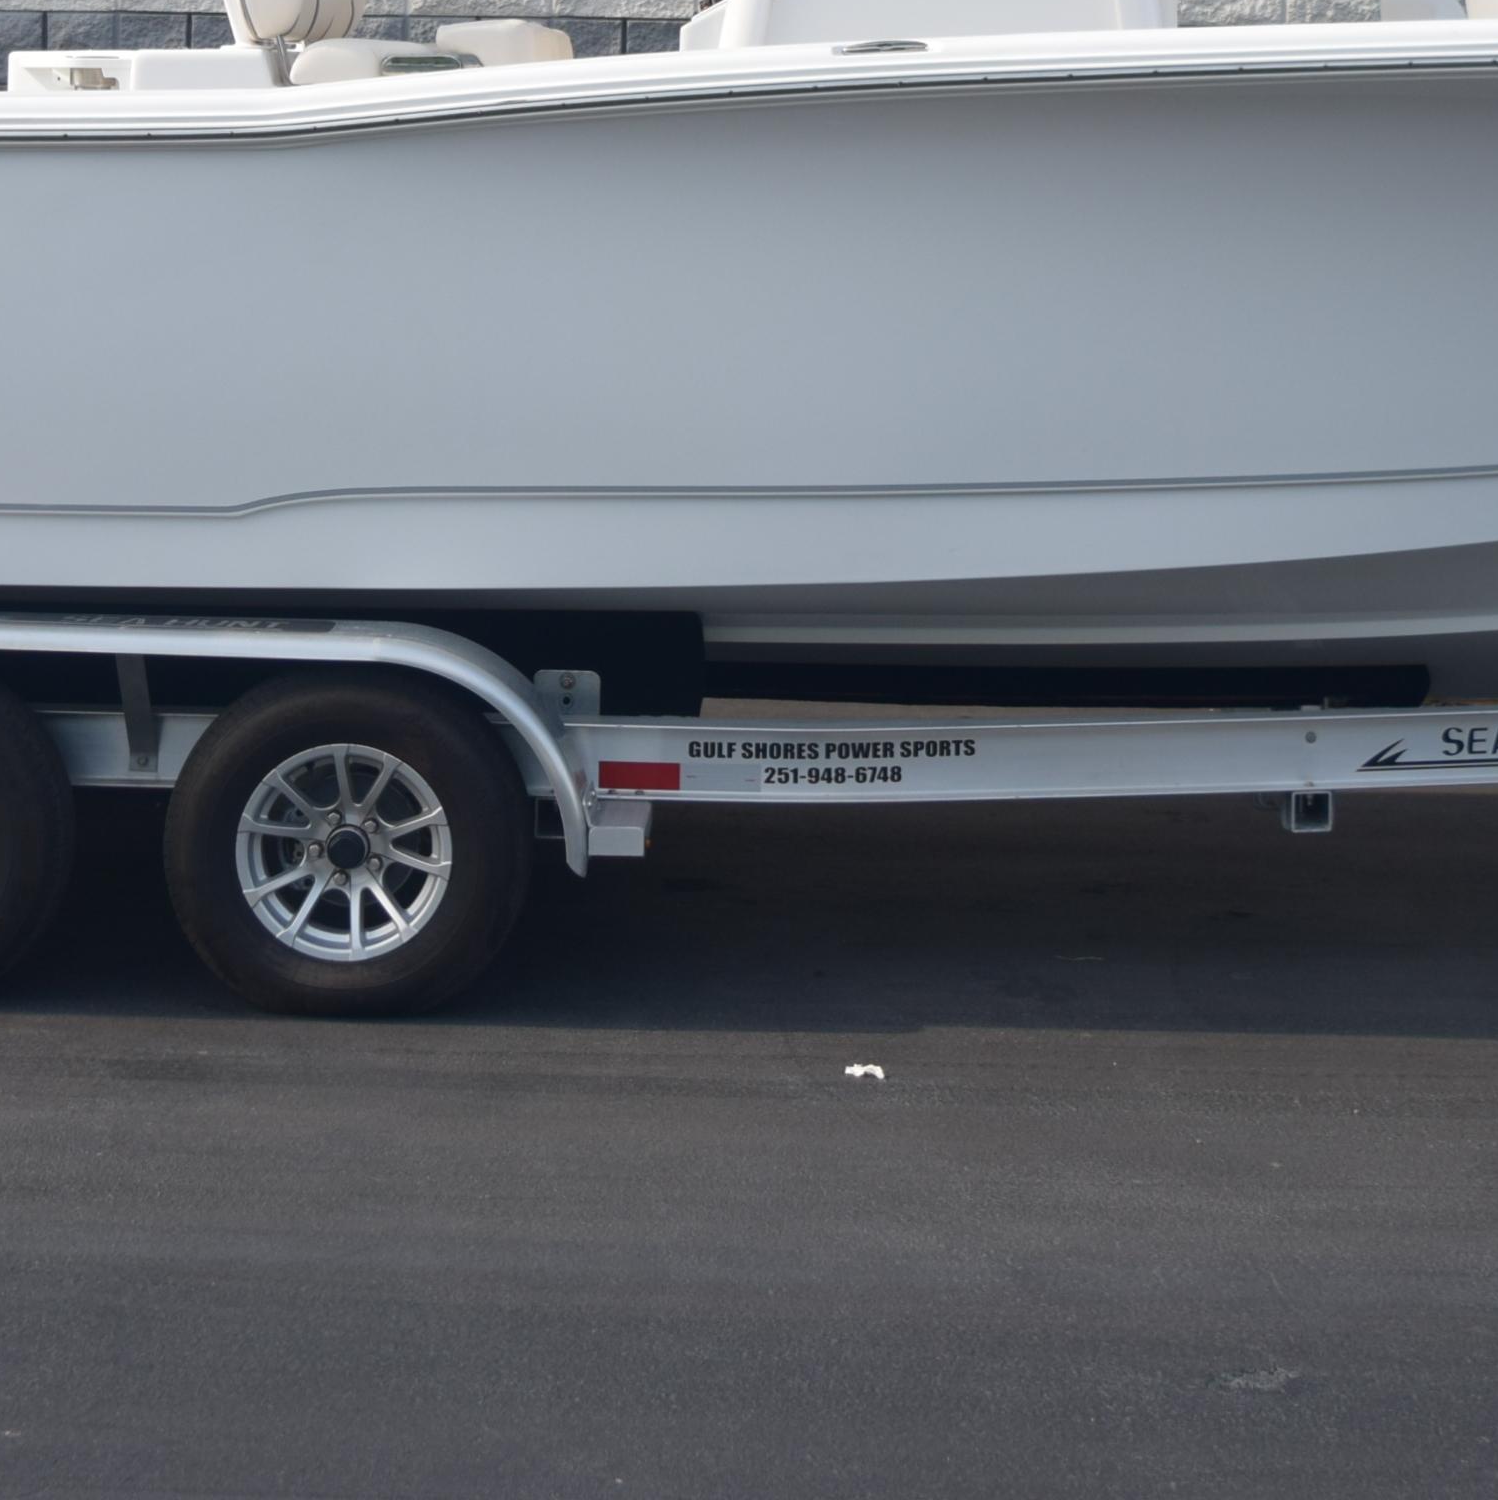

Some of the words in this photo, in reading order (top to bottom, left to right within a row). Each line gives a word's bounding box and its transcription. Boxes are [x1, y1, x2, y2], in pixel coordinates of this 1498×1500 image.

[688, 741, 736, 759] GULF
[741, 742, 819, 760] SHORES
[824, 741, 895, 759] POWER
[900, 739, 976, 758] SPORTS
[763, 766, 902, 784] 251-948-6748
